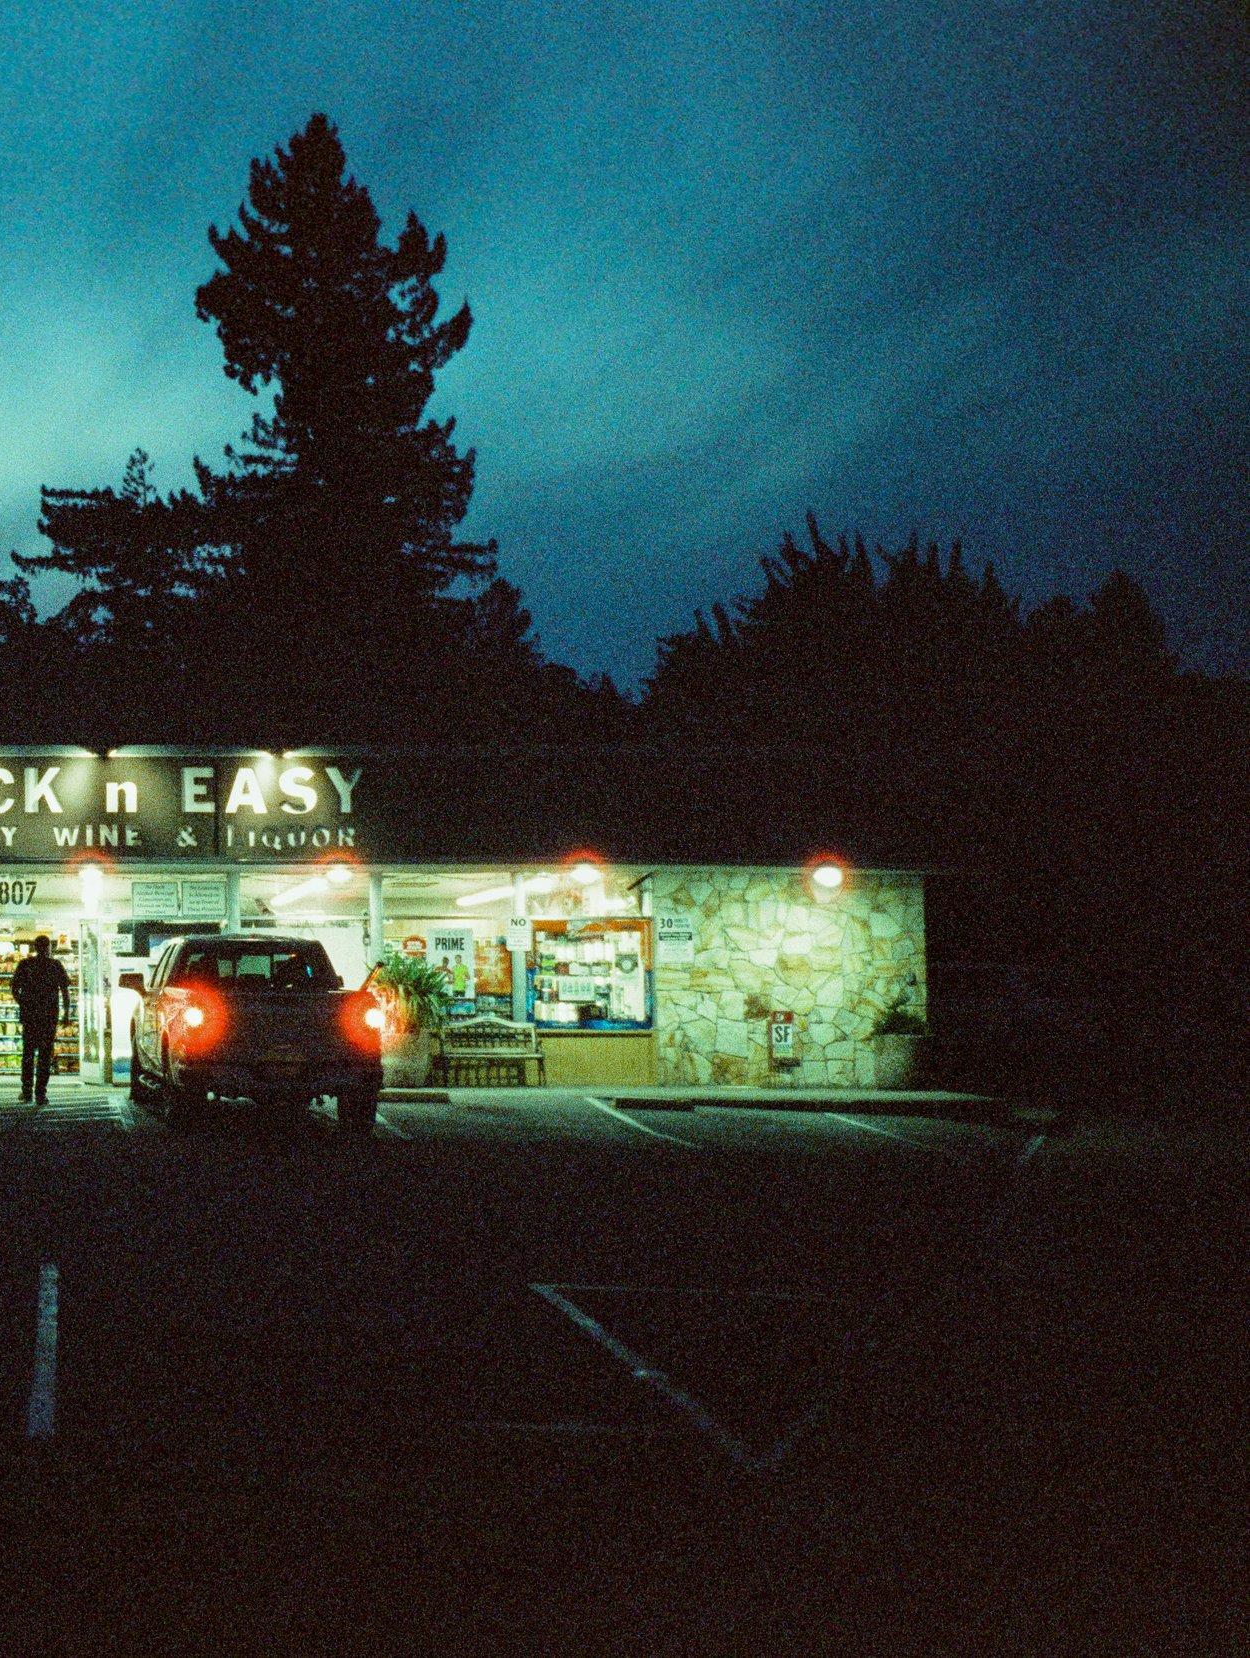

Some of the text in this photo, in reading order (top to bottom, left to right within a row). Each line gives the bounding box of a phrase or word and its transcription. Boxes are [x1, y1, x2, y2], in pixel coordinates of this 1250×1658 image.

[105, 781, 138, 813] n
[180, 766, 363, 815] EASY
[52, 824, 142, 848] WINE
[176, 825, 198, 848] &
[511, 918, 527, 927] NO
[659, 918, 673, 929] 30
[434, 937, 466, 951] PRIME
[774, 1025, 791, 1043] SF
